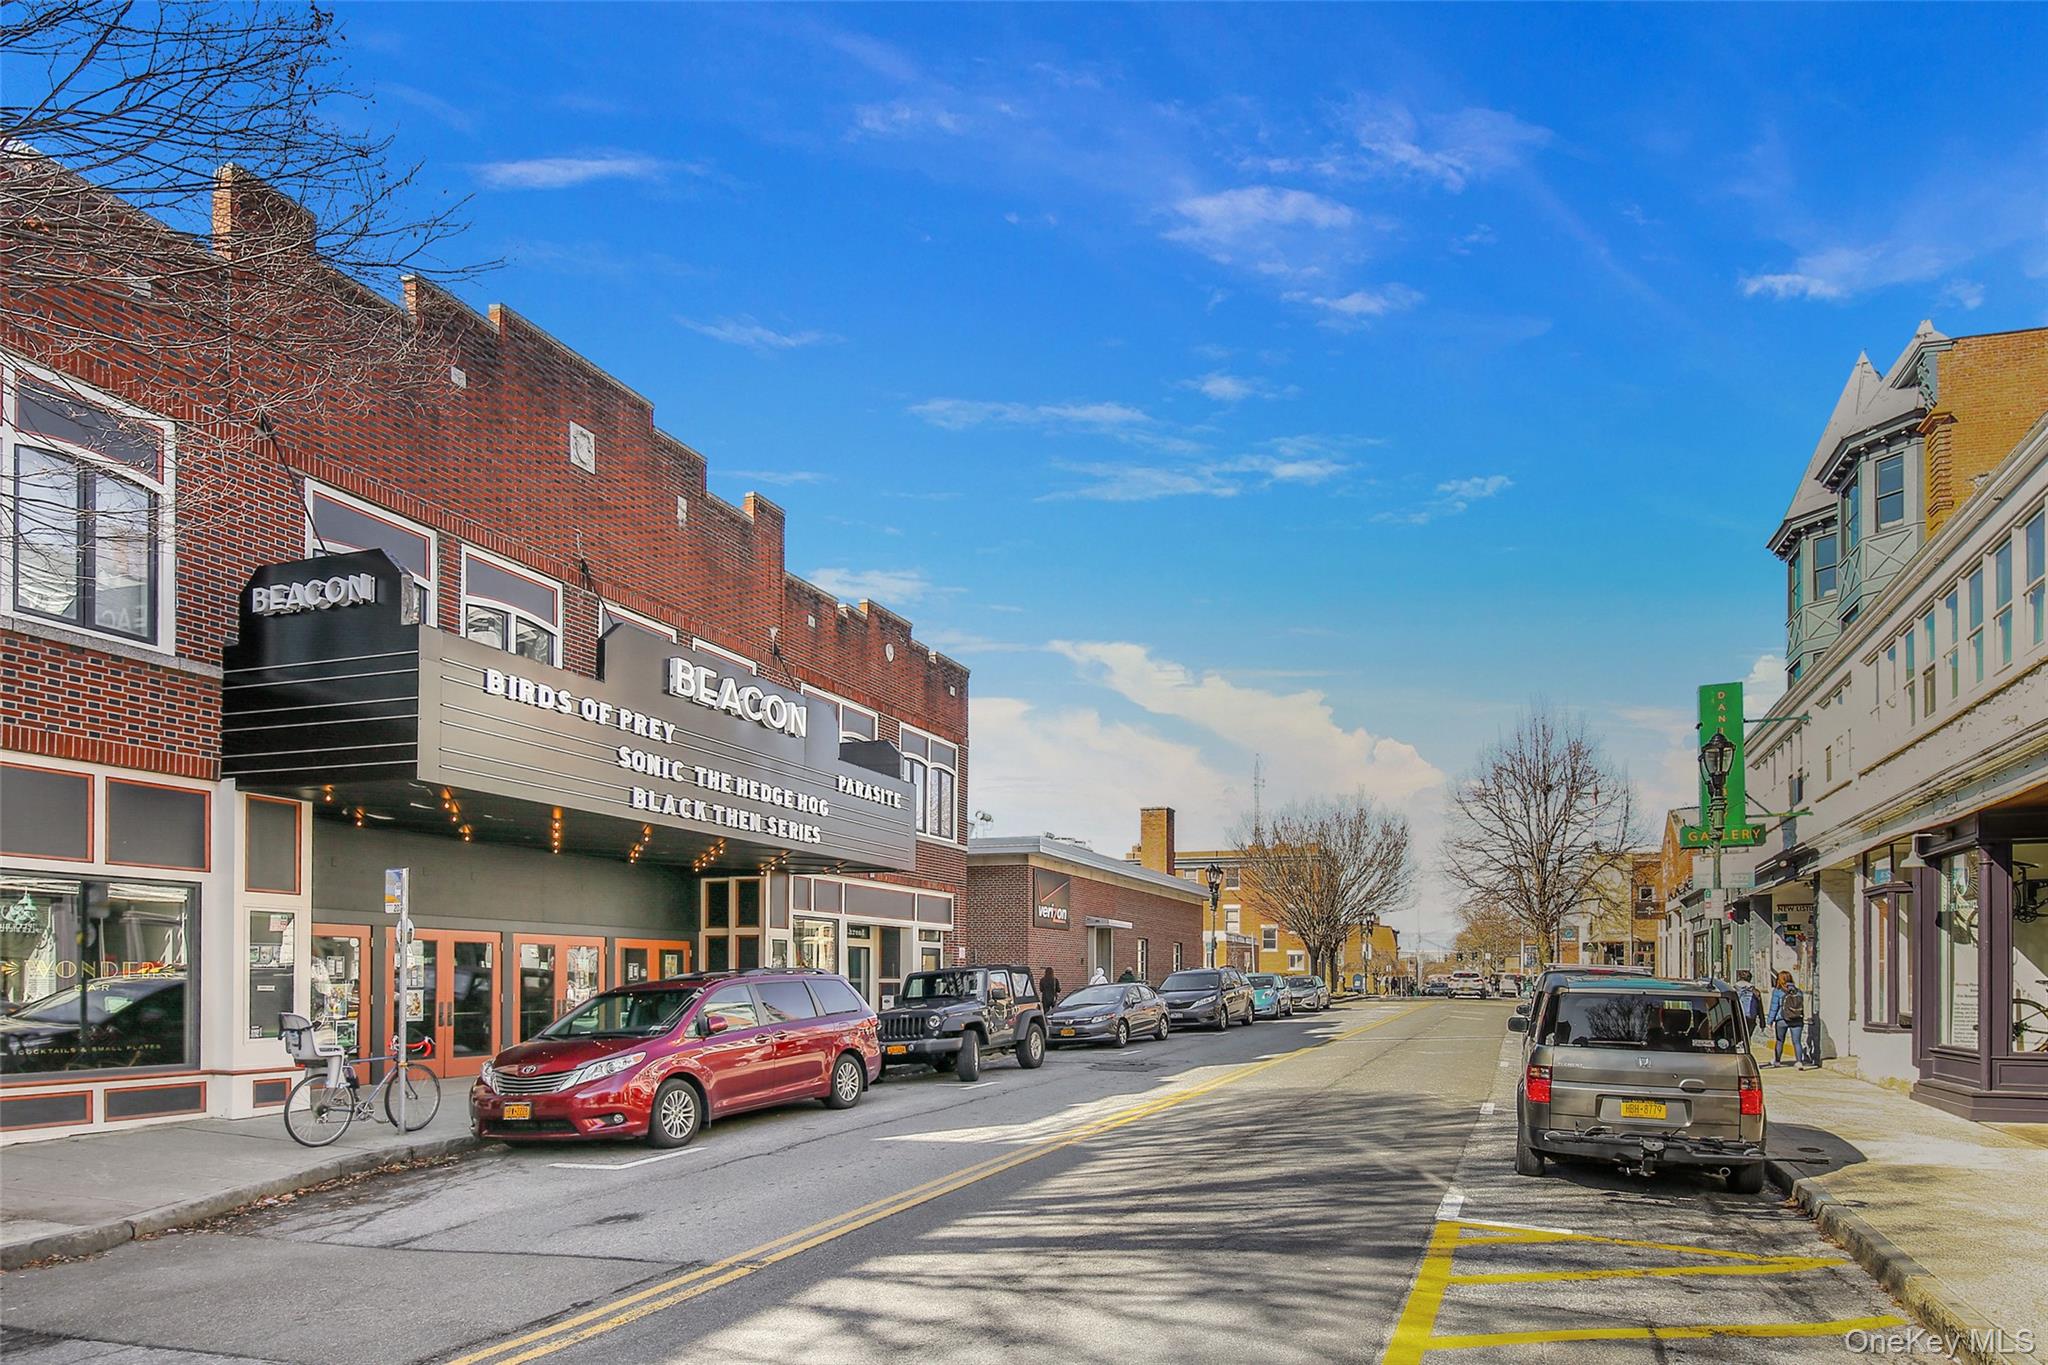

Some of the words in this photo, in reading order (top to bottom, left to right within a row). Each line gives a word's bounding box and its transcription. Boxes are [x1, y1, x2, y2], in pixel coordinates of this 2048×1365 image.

[251, 572, 378, 618] BEACON
[485, 667, 573, 715] BIRDS
[581, 697, 613, 726] OF
[619, 708, 677, 744] PREY
[668, 656, 808, 738] BEACON
[617, 746, 686, 783] SONIC
[694, 766, 732, 795] THE
[736, 777, 796, 809] HEDGE
[797, 792, 831, 818] HOG
[837, 774, 902, 810] PARASITE
[631, 786, 708, 822] BLACK
[712, 804, 761, 833] THEN
[766, 816, 822, 845] SERIES
[1687, 829, 1760, 842] GALERY
[1038, 904, 1067, 924] verizon
[1777, 904, 1794, 912] NEW
[74, 983, 111, 993] BAR
[18, 1047, 77, 1056] COCKTAILS
[126, 1043, 161, 1051] PLATES
